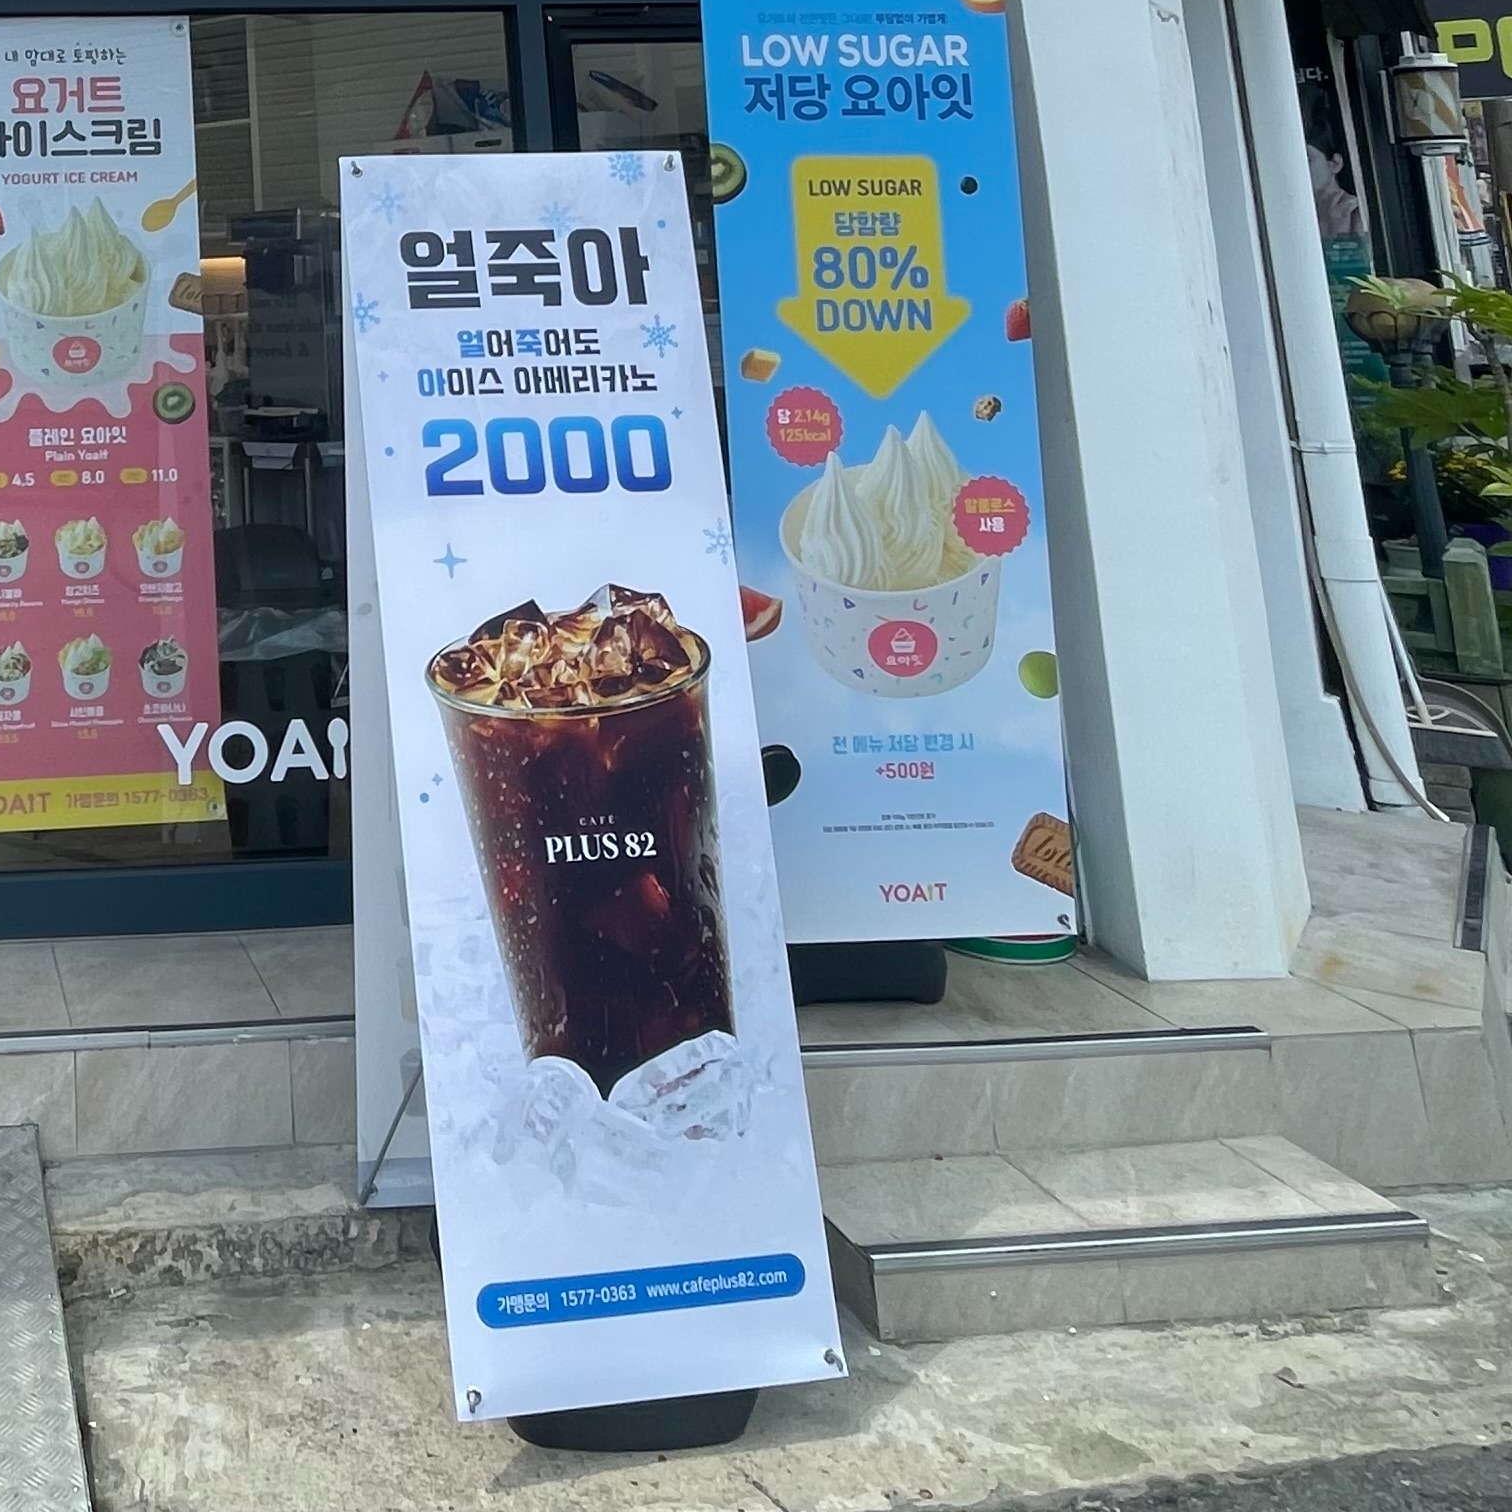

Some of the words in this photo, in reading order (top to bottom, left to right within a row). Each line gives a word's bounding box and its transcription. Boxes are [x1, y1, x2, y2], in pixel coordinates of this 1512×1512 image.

[5, 50, 18, 62] 내
[72, 47, 127, 65] 토핑하는
[741, 35, 829, 68] LOW
[839, 34, 968, 68] SUGAR
[11, 76, 125, 114] 요거트
[744, 73, 832, 121] 저당
[841, 72, 974, 121] 요아잇
[1, 172, 59, 185] YOGURT
[63, 172, 86, 184] ICE
[90, 171, 138, 184] CREAM
[808, 179, 851, 197] LOW
[857, 179, 922, 197] SUGAR
[834, 211, 902, 237] 당함량
[400, 227, 649, 309] 얼죽아
[813, 244, 929, 291] 80%
[816, 298, 932, 332] DOWN
[457, 328, 601, 358] 얼어죽어도
[417, 367, 505, 397] 아이스
[514, 364, 657, 395] 아메리카노
[28, 428, 75, 447] 플레인
[80, 426, 127, 445] 요아잇
[779, 428, 831, 443] 125kcal
[45, 450, 75, 462] Plain
[422, 415, 672, 497] 2000
[12, 473, 35, 487] 4.5
[81, 471, 105, 484] 8.0
[151, 468, 178, 482] 11.0
[979, 516, 1005, 532] 사용
[156, 718, 349, 785] YOAI
[832, 736, 847, 755] 전
[853, 736, 884, 754] 메뉴
[888, 735, 919, 753] 저당
[924, 733, 954, 752] 변경
[958, 732, 974, 751] 시
[875, 761, 935, 780] +500원
[544, 832, 620, 864] PLUS
[624, 831, 657, 858] 82
[879, 882, 948, 903] YOAIT
[497, 1292, 550, 1315] 가맹문의
[560, 1285, 637, 1307] 1577-0363
[646, 1270, 788, 1299] www.cafeplus82.com
